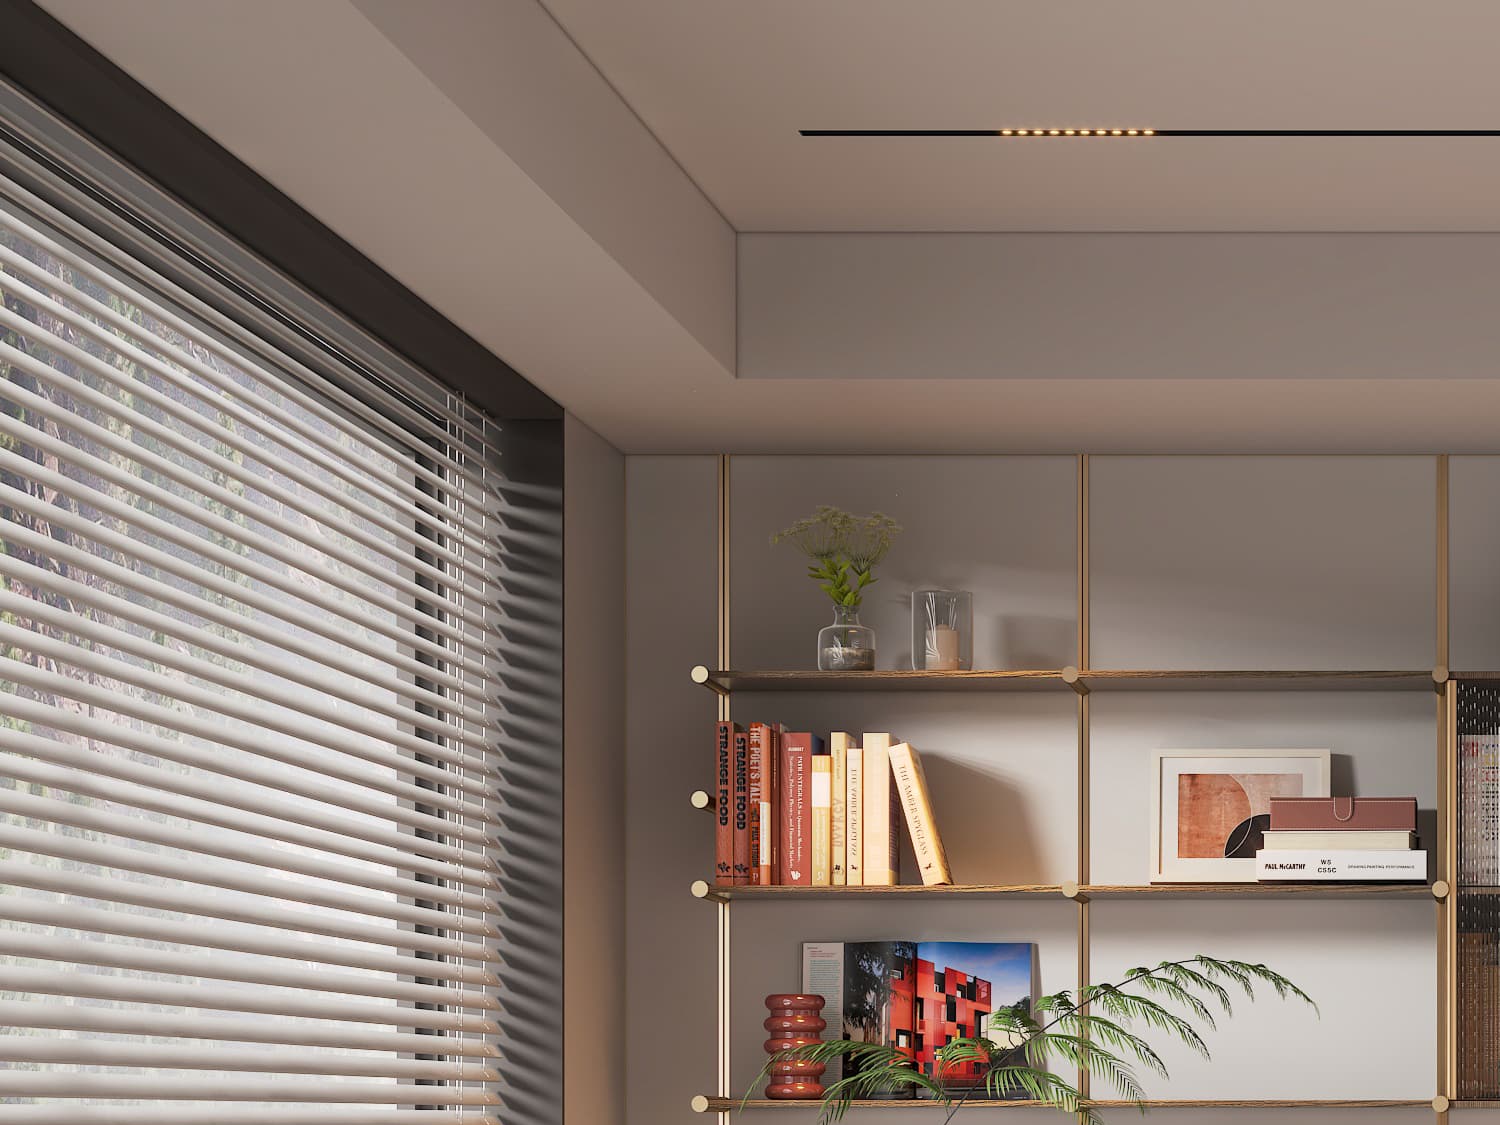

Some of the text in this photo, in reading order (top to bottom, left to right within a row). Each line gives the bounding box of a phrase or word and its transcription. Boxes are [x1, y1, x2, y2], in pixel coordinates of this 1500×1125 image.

[719, 726, 729, 826] STRANGE FOOD
[736, 737, 746, 830] STRANGE FOOD
[750, 726, 761, 804] THE POET'S TALE
[898, 765, 929, 856] THE AMBER SPYGLASS
